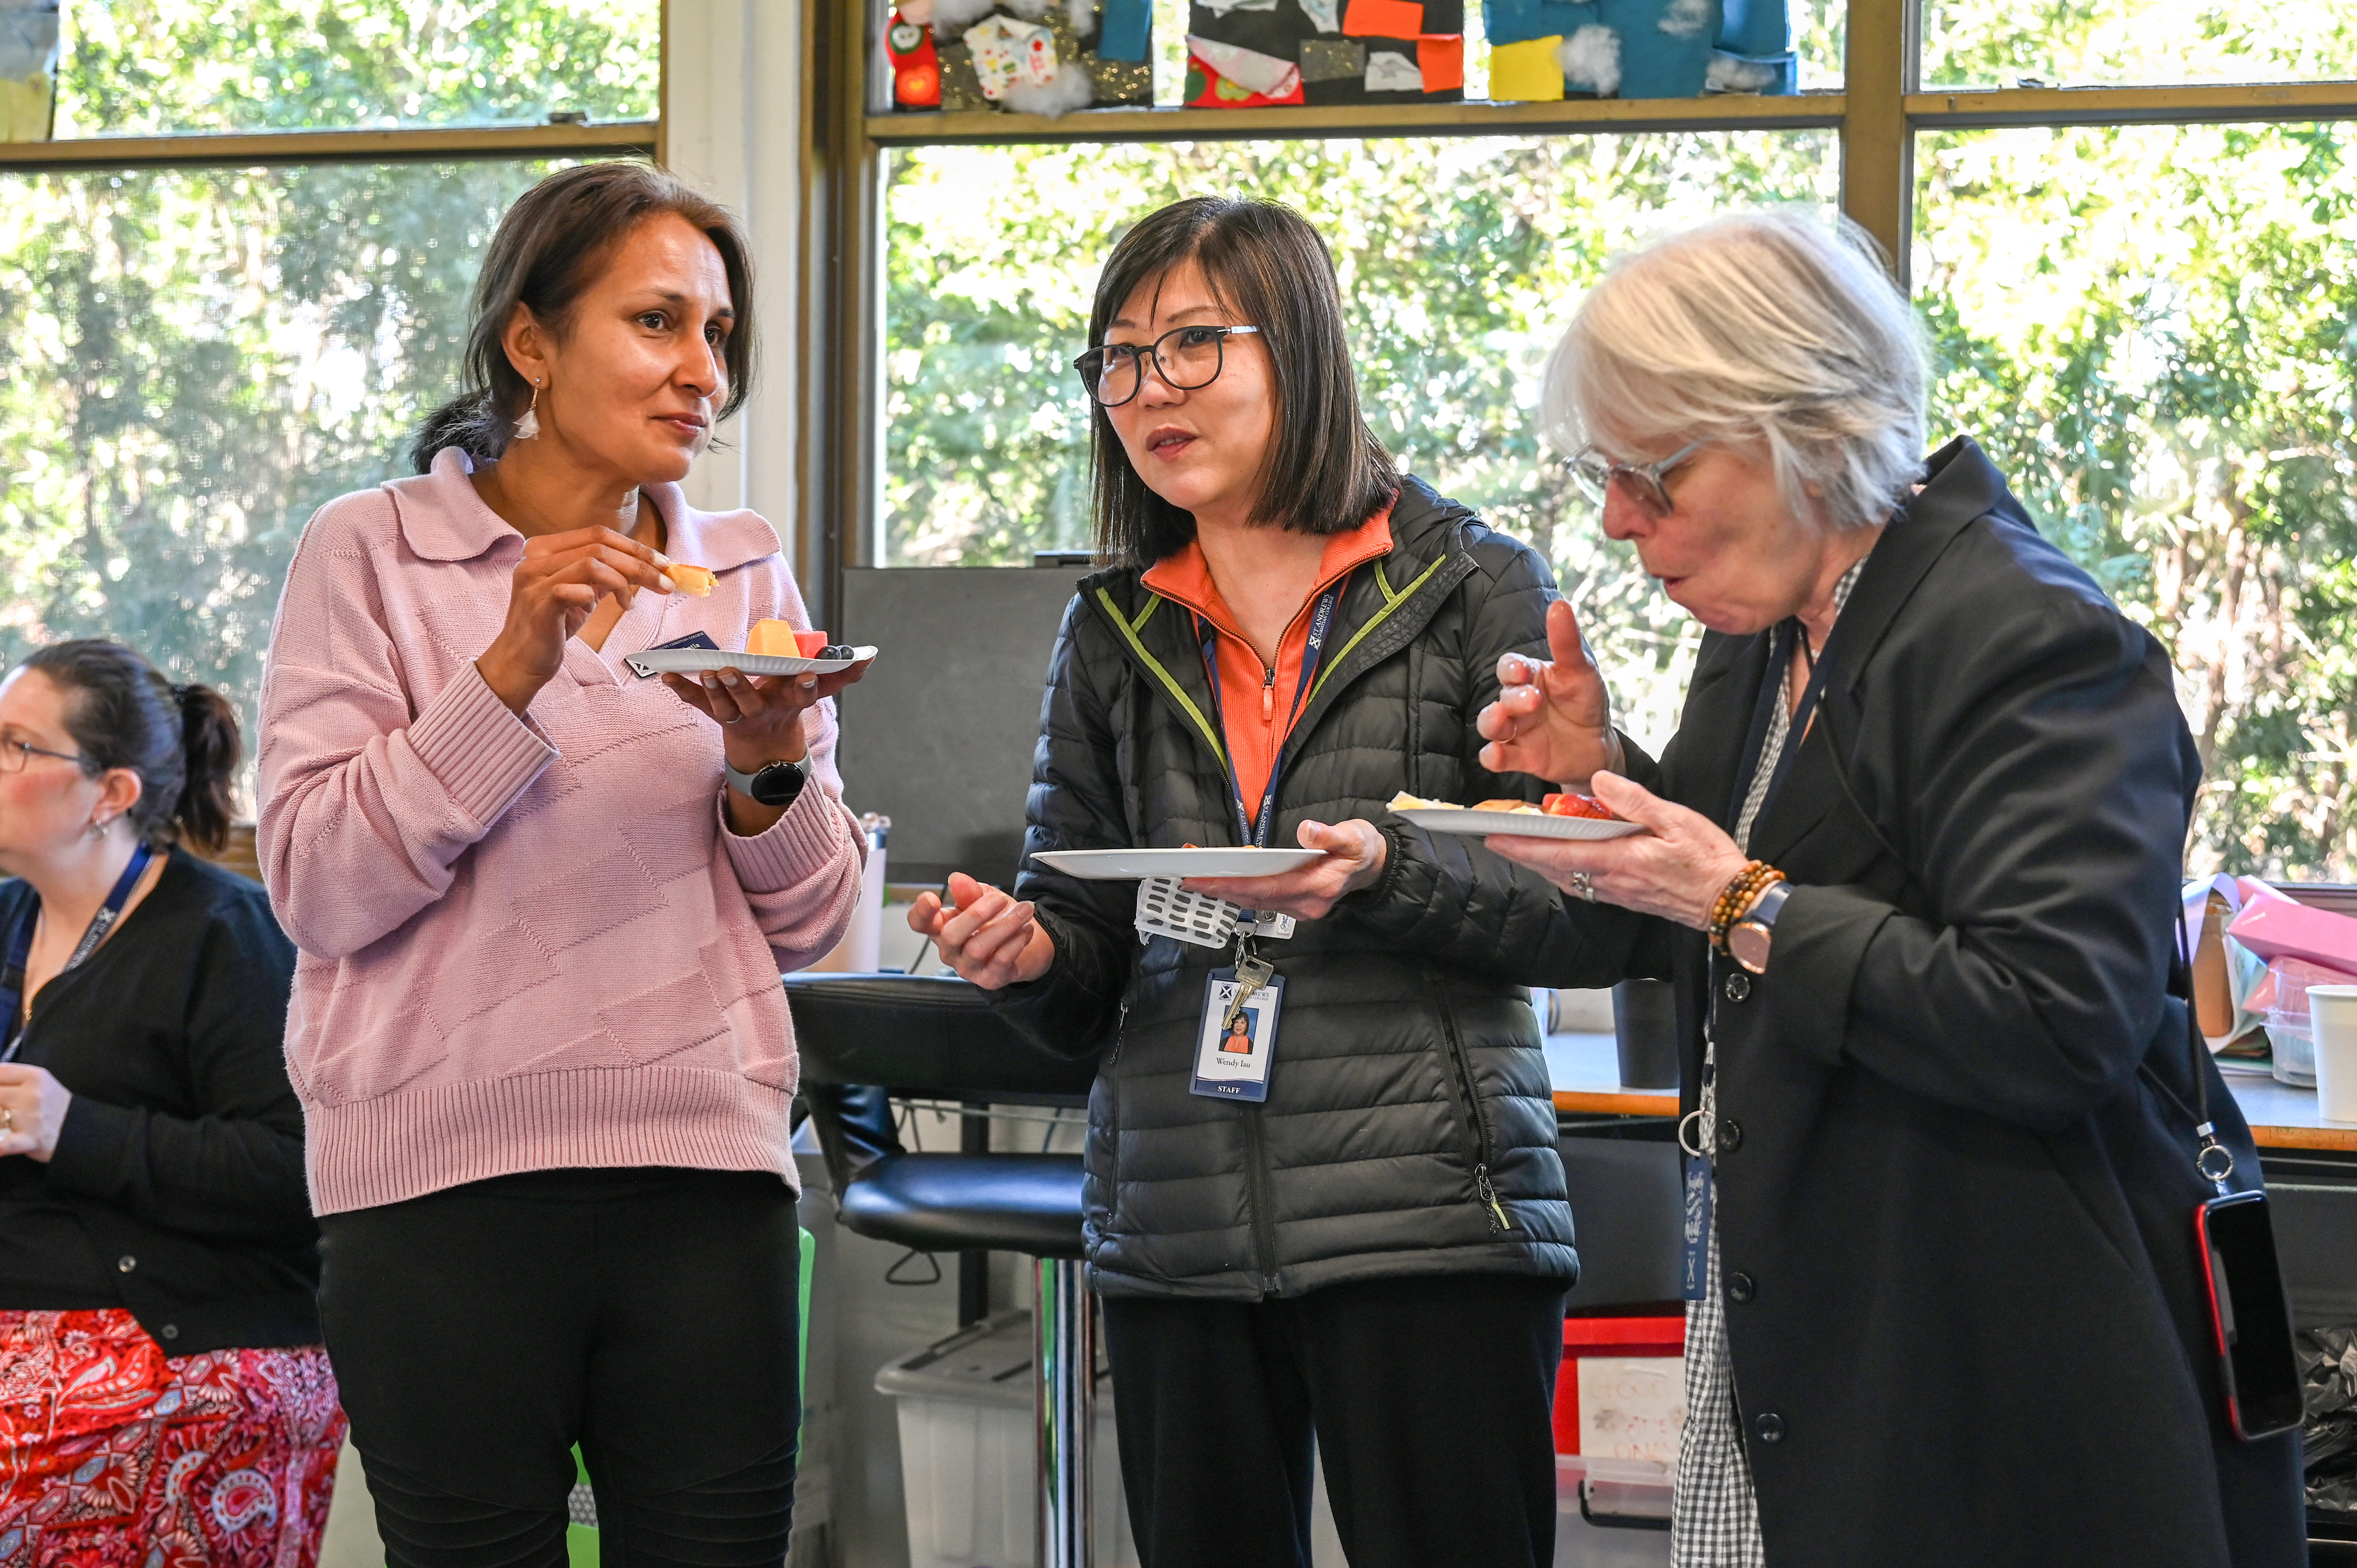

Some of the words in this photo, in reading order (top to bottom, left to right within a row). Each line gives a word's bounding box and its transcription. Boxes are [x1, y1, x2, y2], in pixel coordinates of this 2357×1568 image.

[1312, 627, 1319, 637] ST
[1316, 593, 1330, 628] ANDREWS
[1318, 615, 1327, 639] CHRISTIAN
[1325, 596, 1334, 615] COLLEGE
[669, 638, 689, 647] CHRISTIAN
[1216, 1057, 1239, 1068] Wendy
[1217, 1085, 1241, 1094] STAFF
